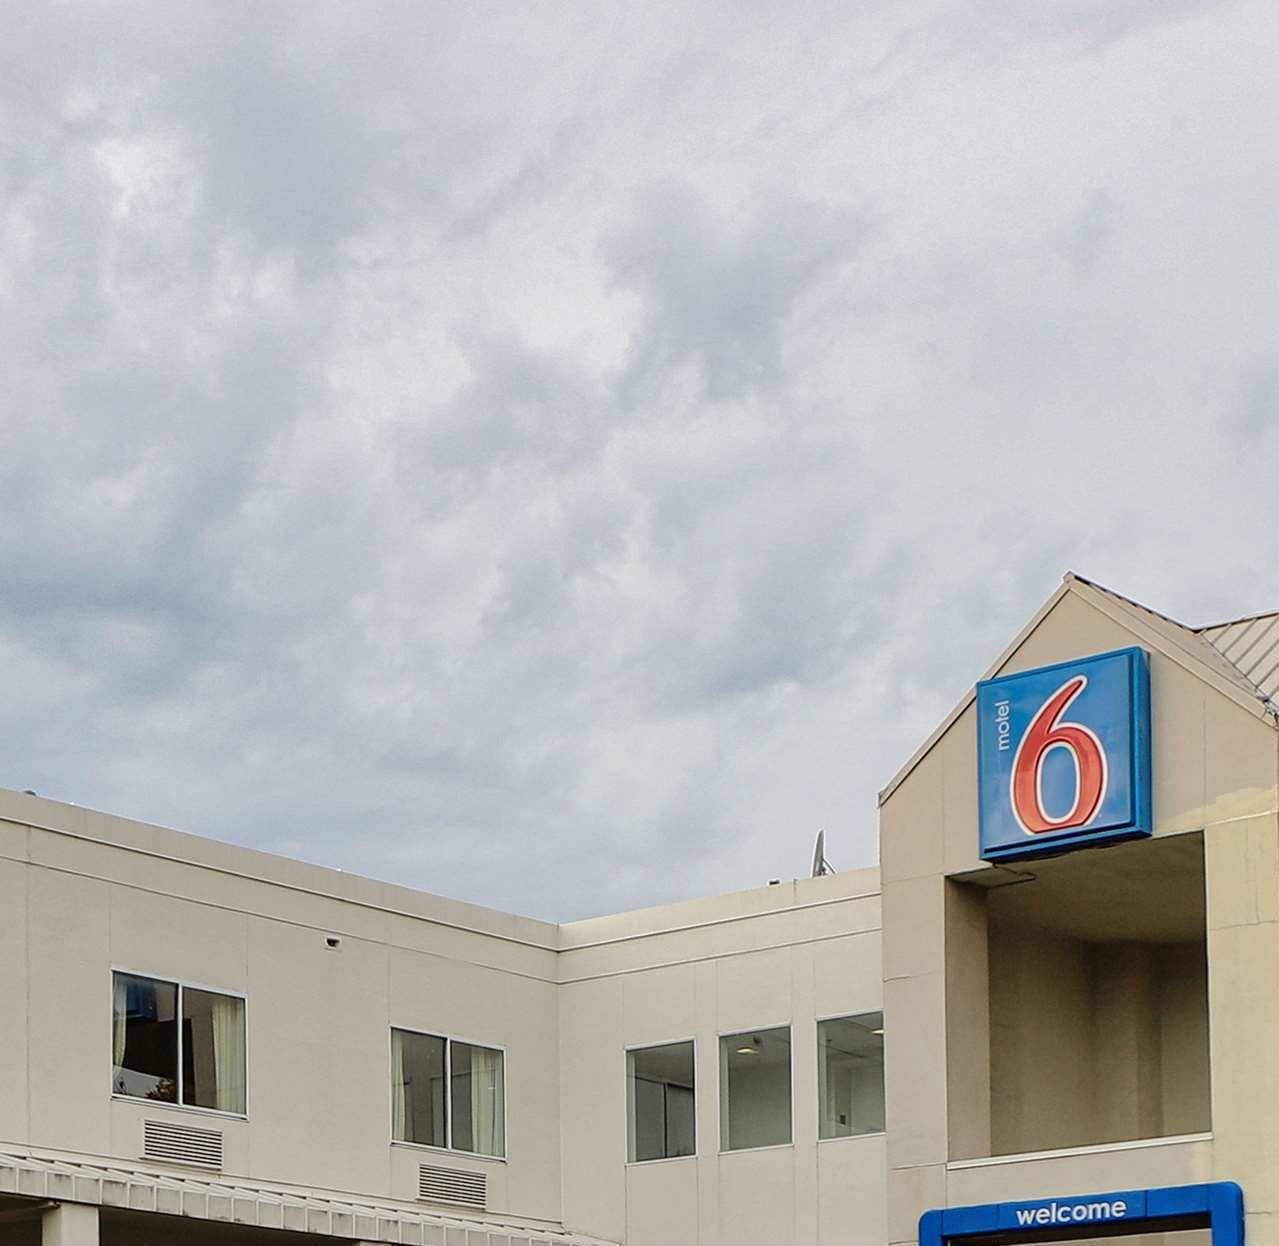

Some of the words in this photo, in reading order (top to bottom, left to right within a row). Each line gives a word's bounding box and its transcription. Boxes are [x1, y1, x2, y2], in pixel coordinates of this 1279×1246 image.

[995, 700, 1010, 751] motel
[1010, 675, 1108, 836] 6
[1016, 1201, 1127, 1225] welcome
